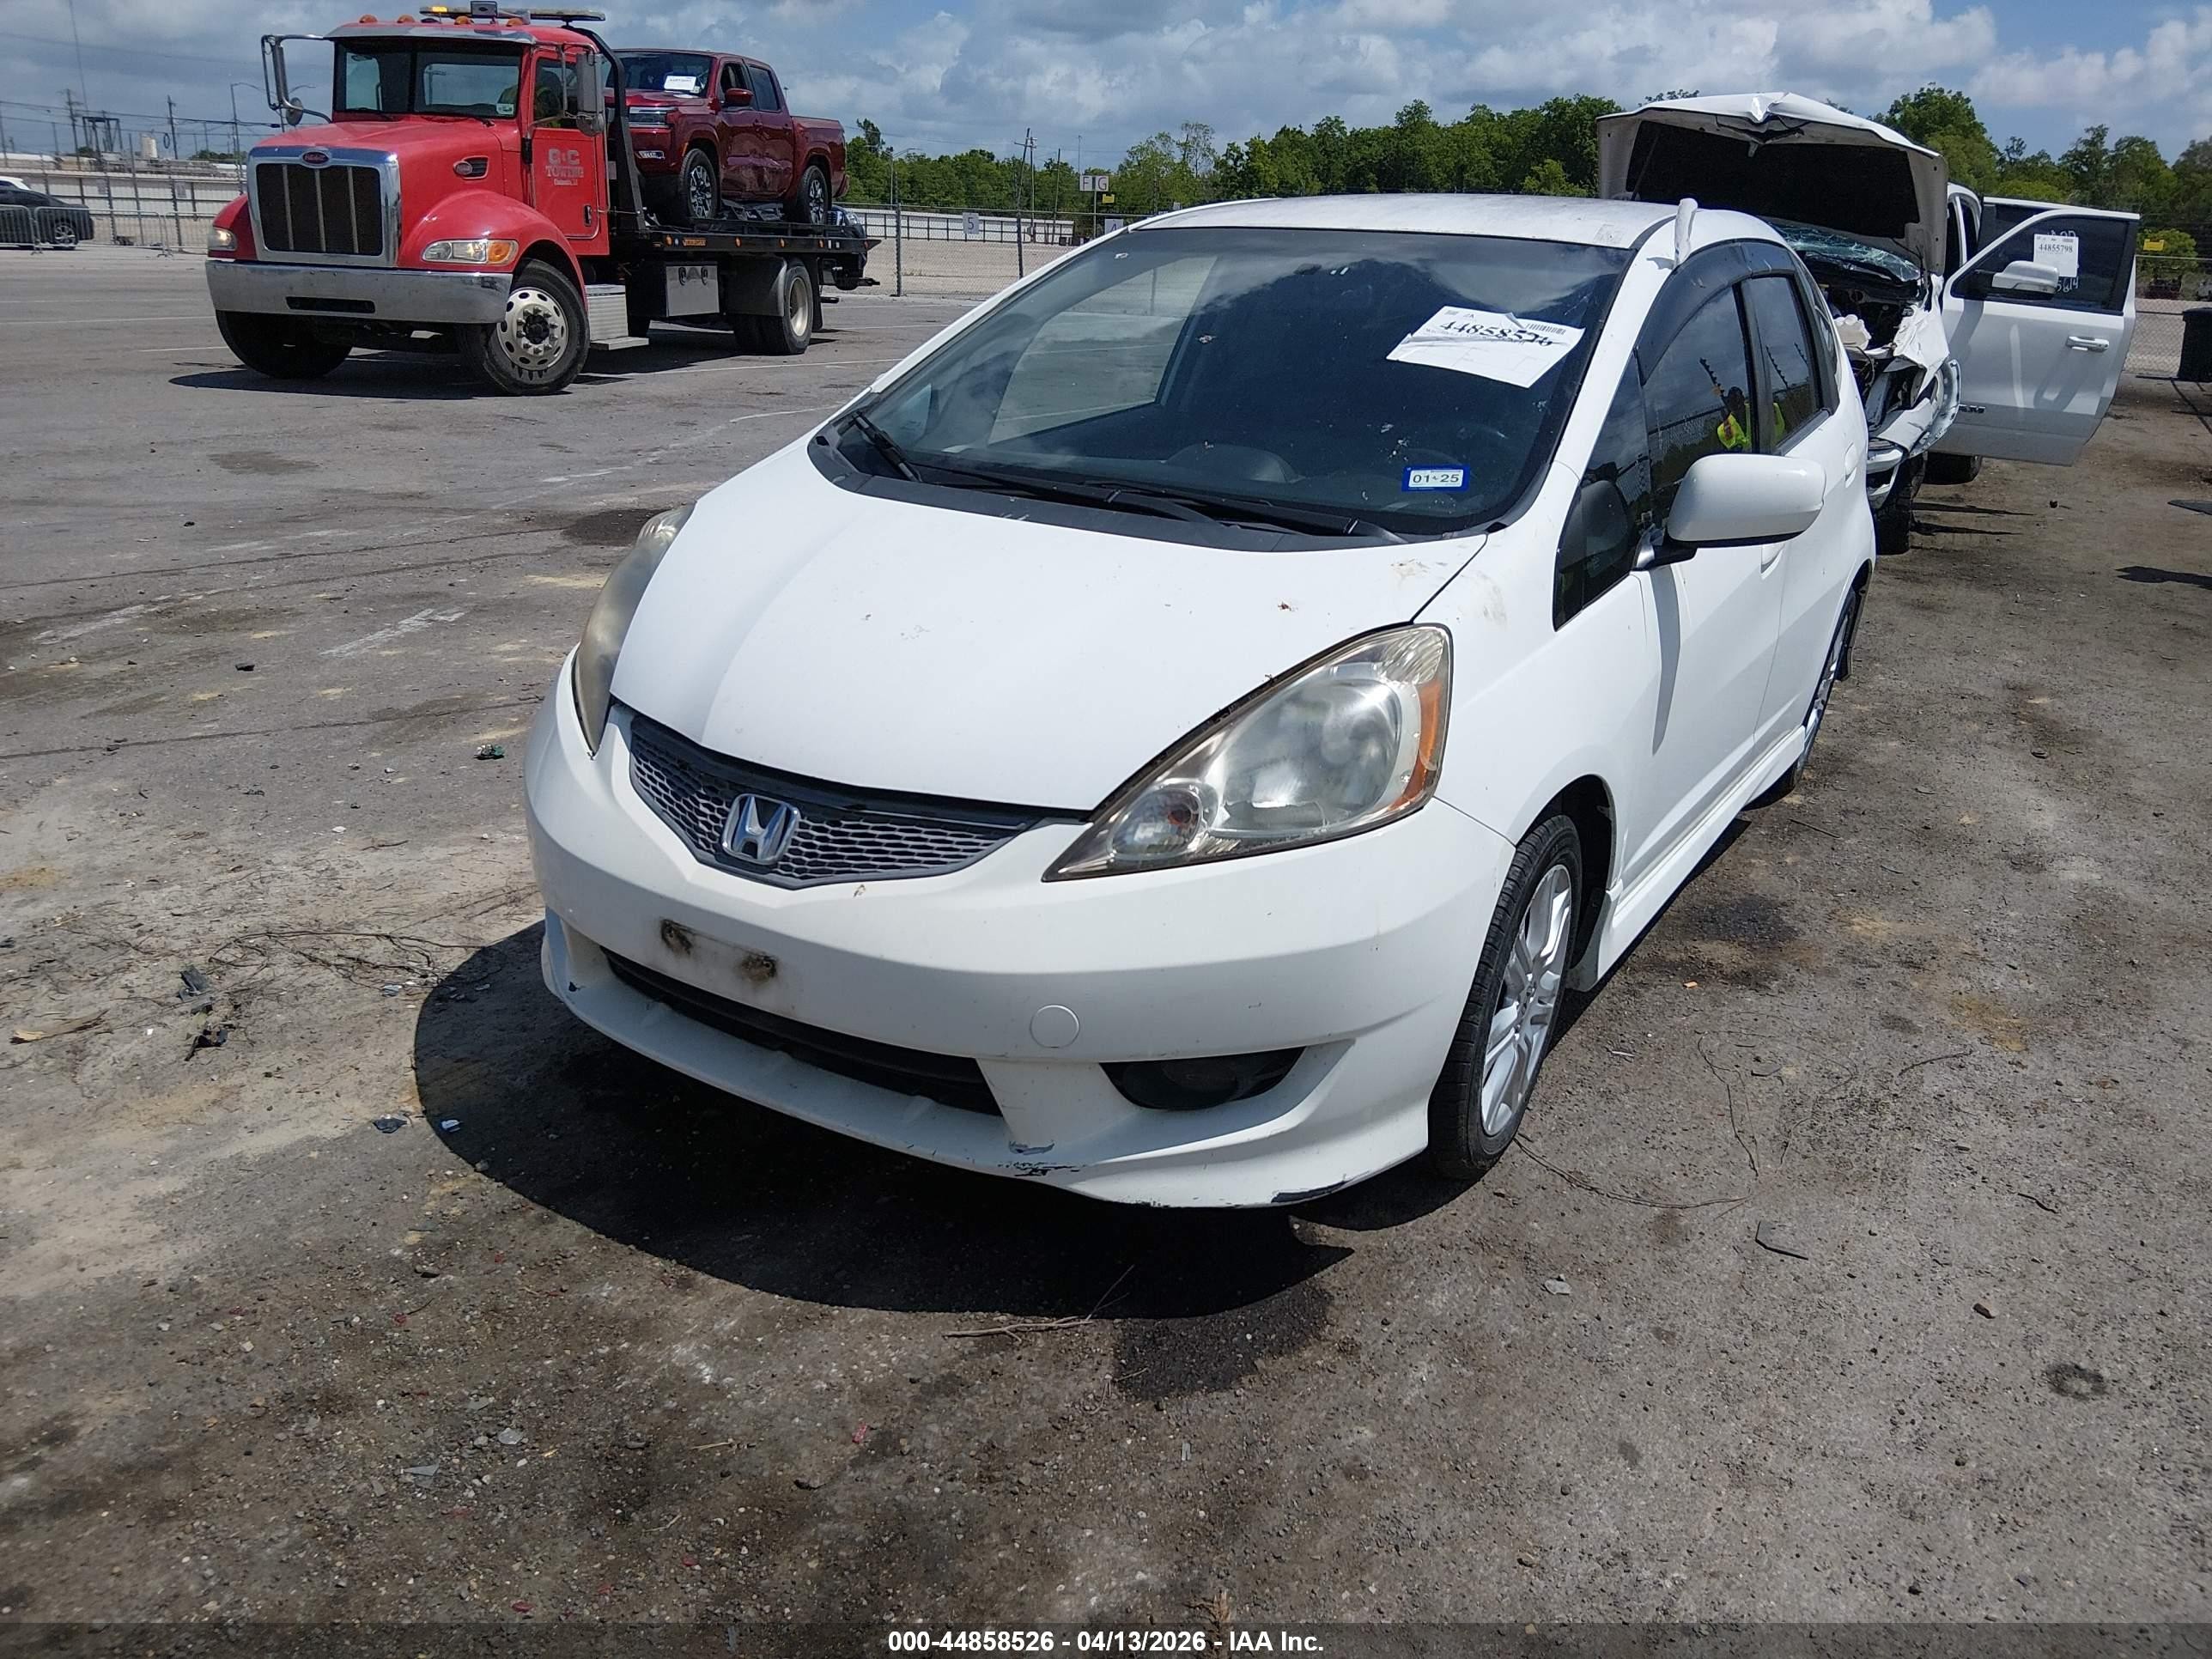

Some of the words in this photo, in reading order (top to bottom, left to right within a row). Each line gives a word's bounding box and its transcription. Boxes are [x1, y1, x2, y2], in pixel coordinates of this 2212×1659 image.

[1083, 176, 1090, 191] F
[1097, 176, 1107, 191] G
[968, 216, 975, 230] 5
[1413, 474, 1430, 483] 01
[1439, 473, 1460, 483] 25
